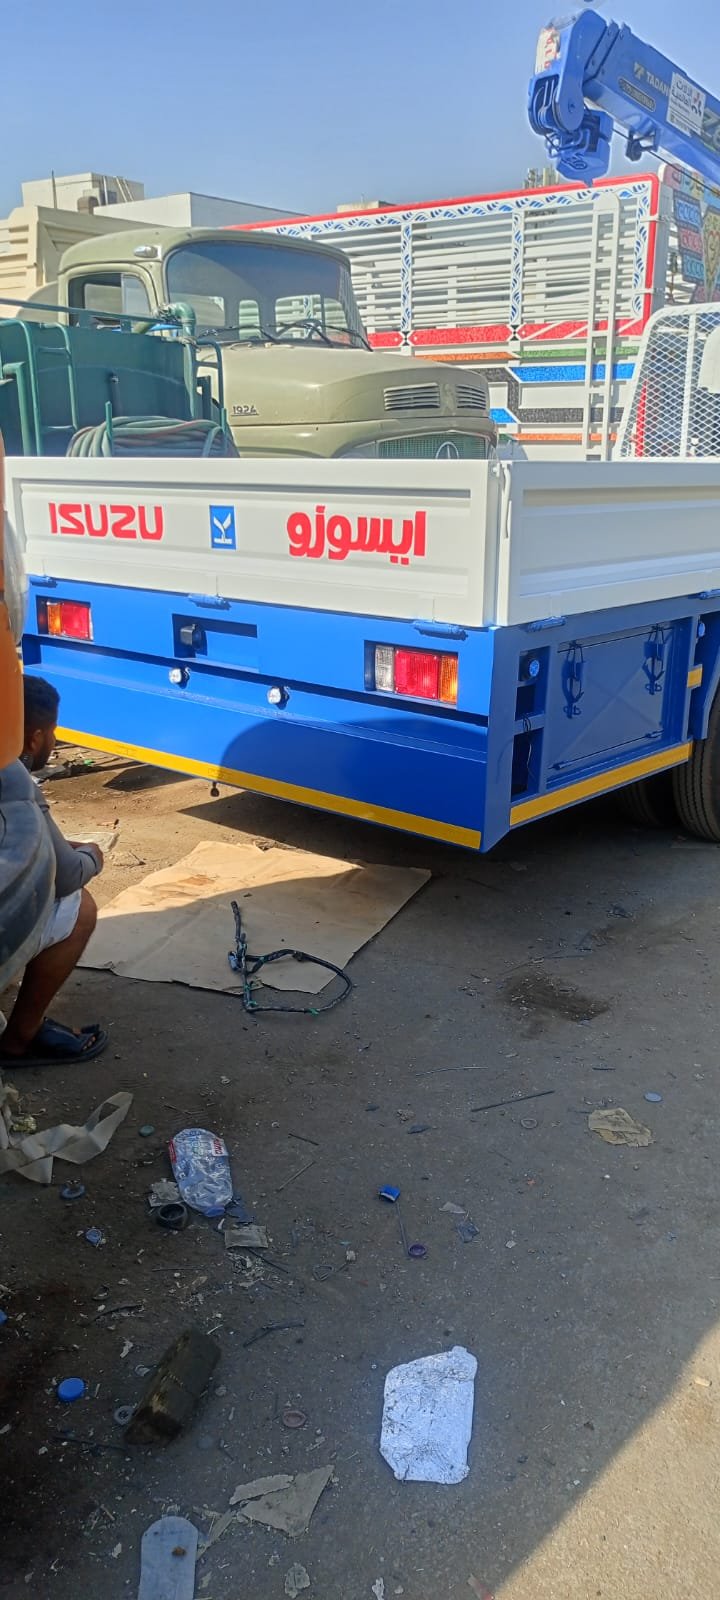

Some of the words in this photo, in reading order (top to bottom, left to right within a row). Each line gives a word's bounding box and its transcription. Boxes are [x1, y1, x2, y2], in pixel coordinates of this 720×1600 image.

[233, 405, 256, 414] 1924
[48, 502, 163, 541] ISUZU
[287, 505, 426, 565] ايسوزو
